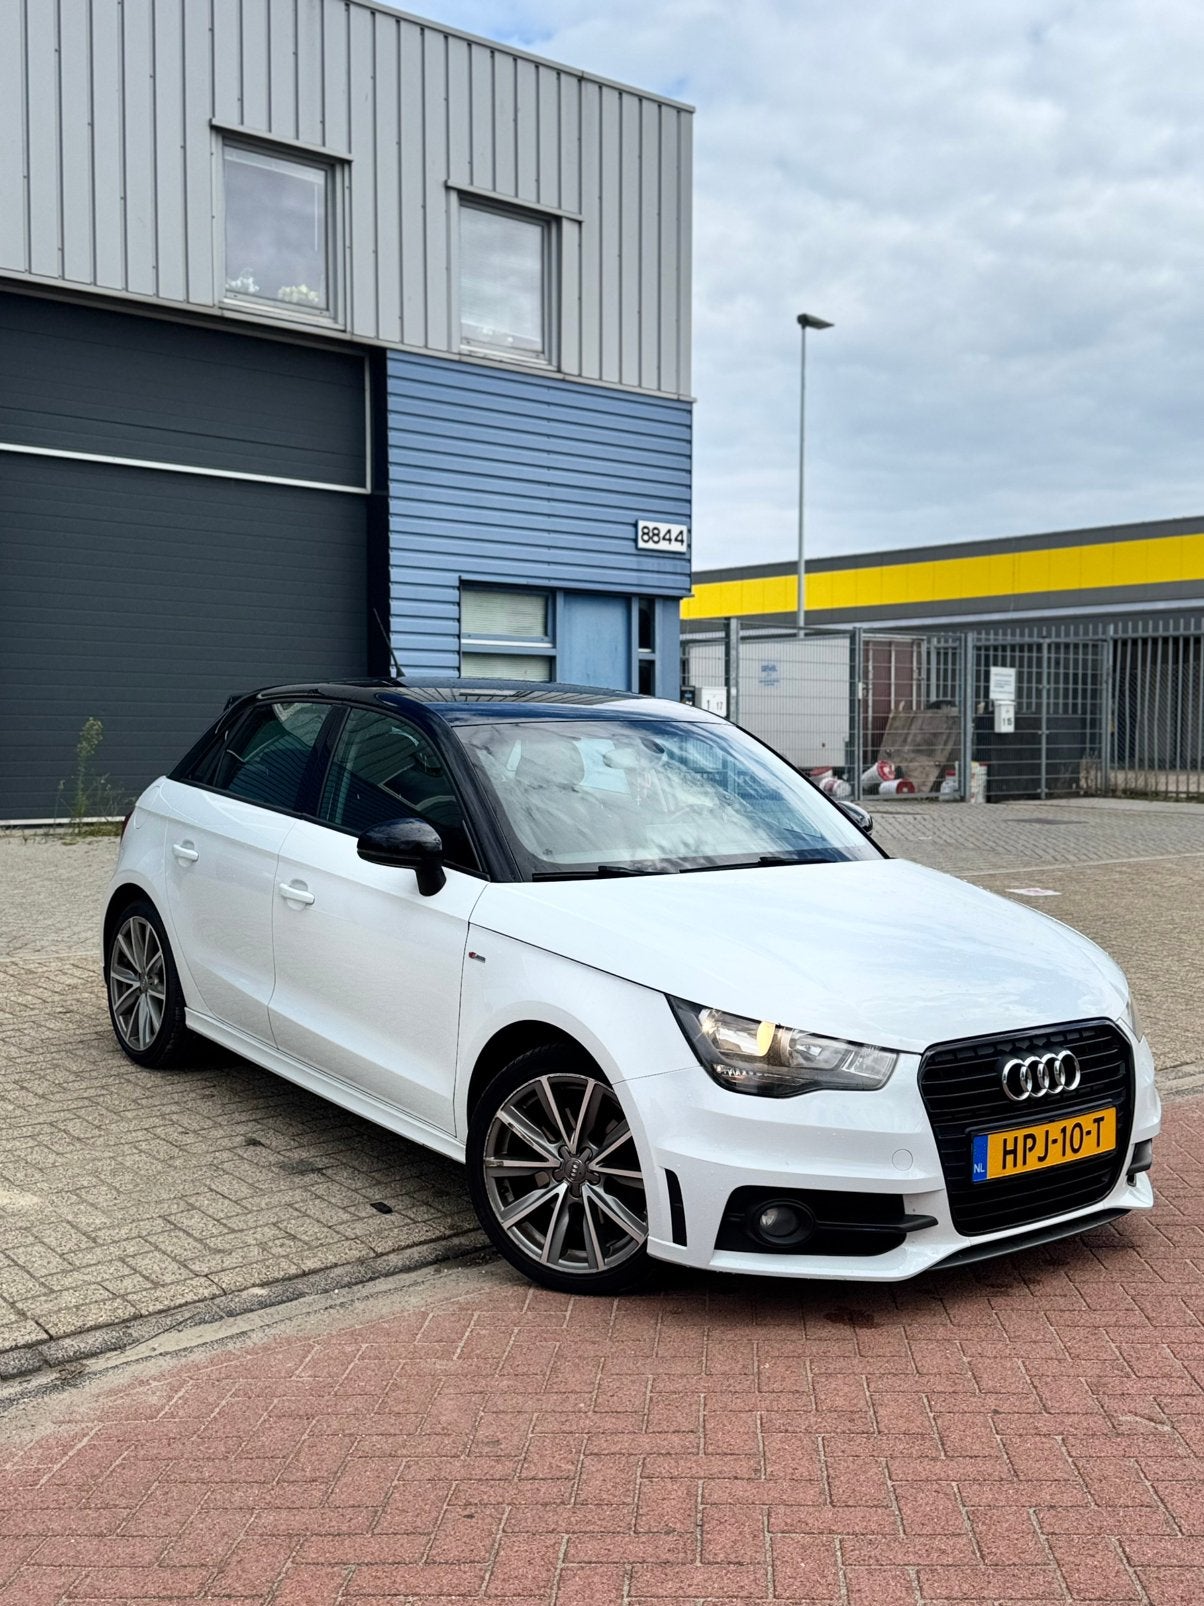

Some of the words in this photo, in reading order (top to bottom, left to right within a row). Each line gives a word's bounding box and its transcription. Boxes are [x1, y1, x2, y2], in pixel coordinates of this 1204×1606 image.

[641, 525, 685, 546] 8844
[1002, 1116, 1105, 1170] HPJ-10-T
[973, 1163, 985, 1173] NL
